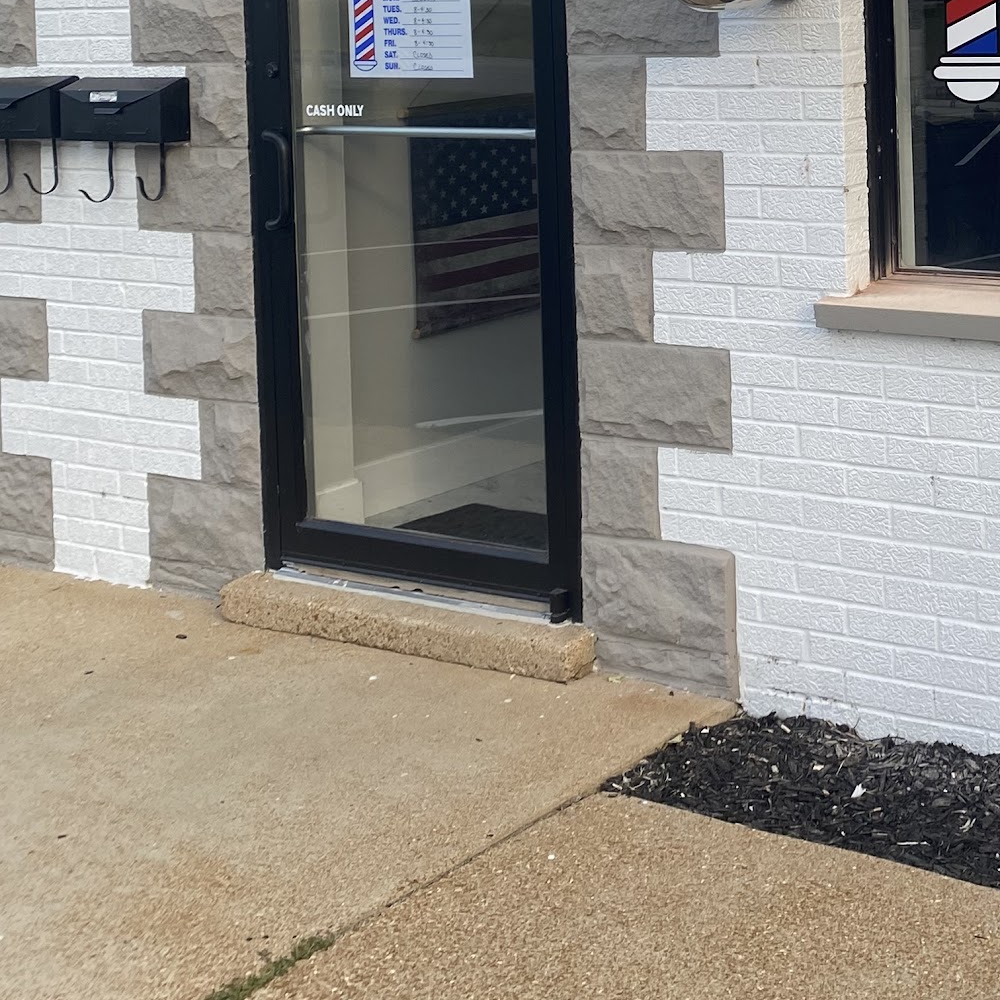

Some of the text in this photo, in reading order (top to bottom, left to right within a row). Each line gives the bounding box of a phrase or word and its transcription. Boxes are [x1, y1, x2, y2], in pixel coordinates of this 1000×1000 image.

[383, 5, 402, 13] TUES.
[383, 16, 401, 24] WED.
[384, 28, 408, 36] THURS.
[384, 51, 399, 59] SAT.
[385, 62, 401, 70] SUN.
[306, 104, 364, 117] CASH ONLY
